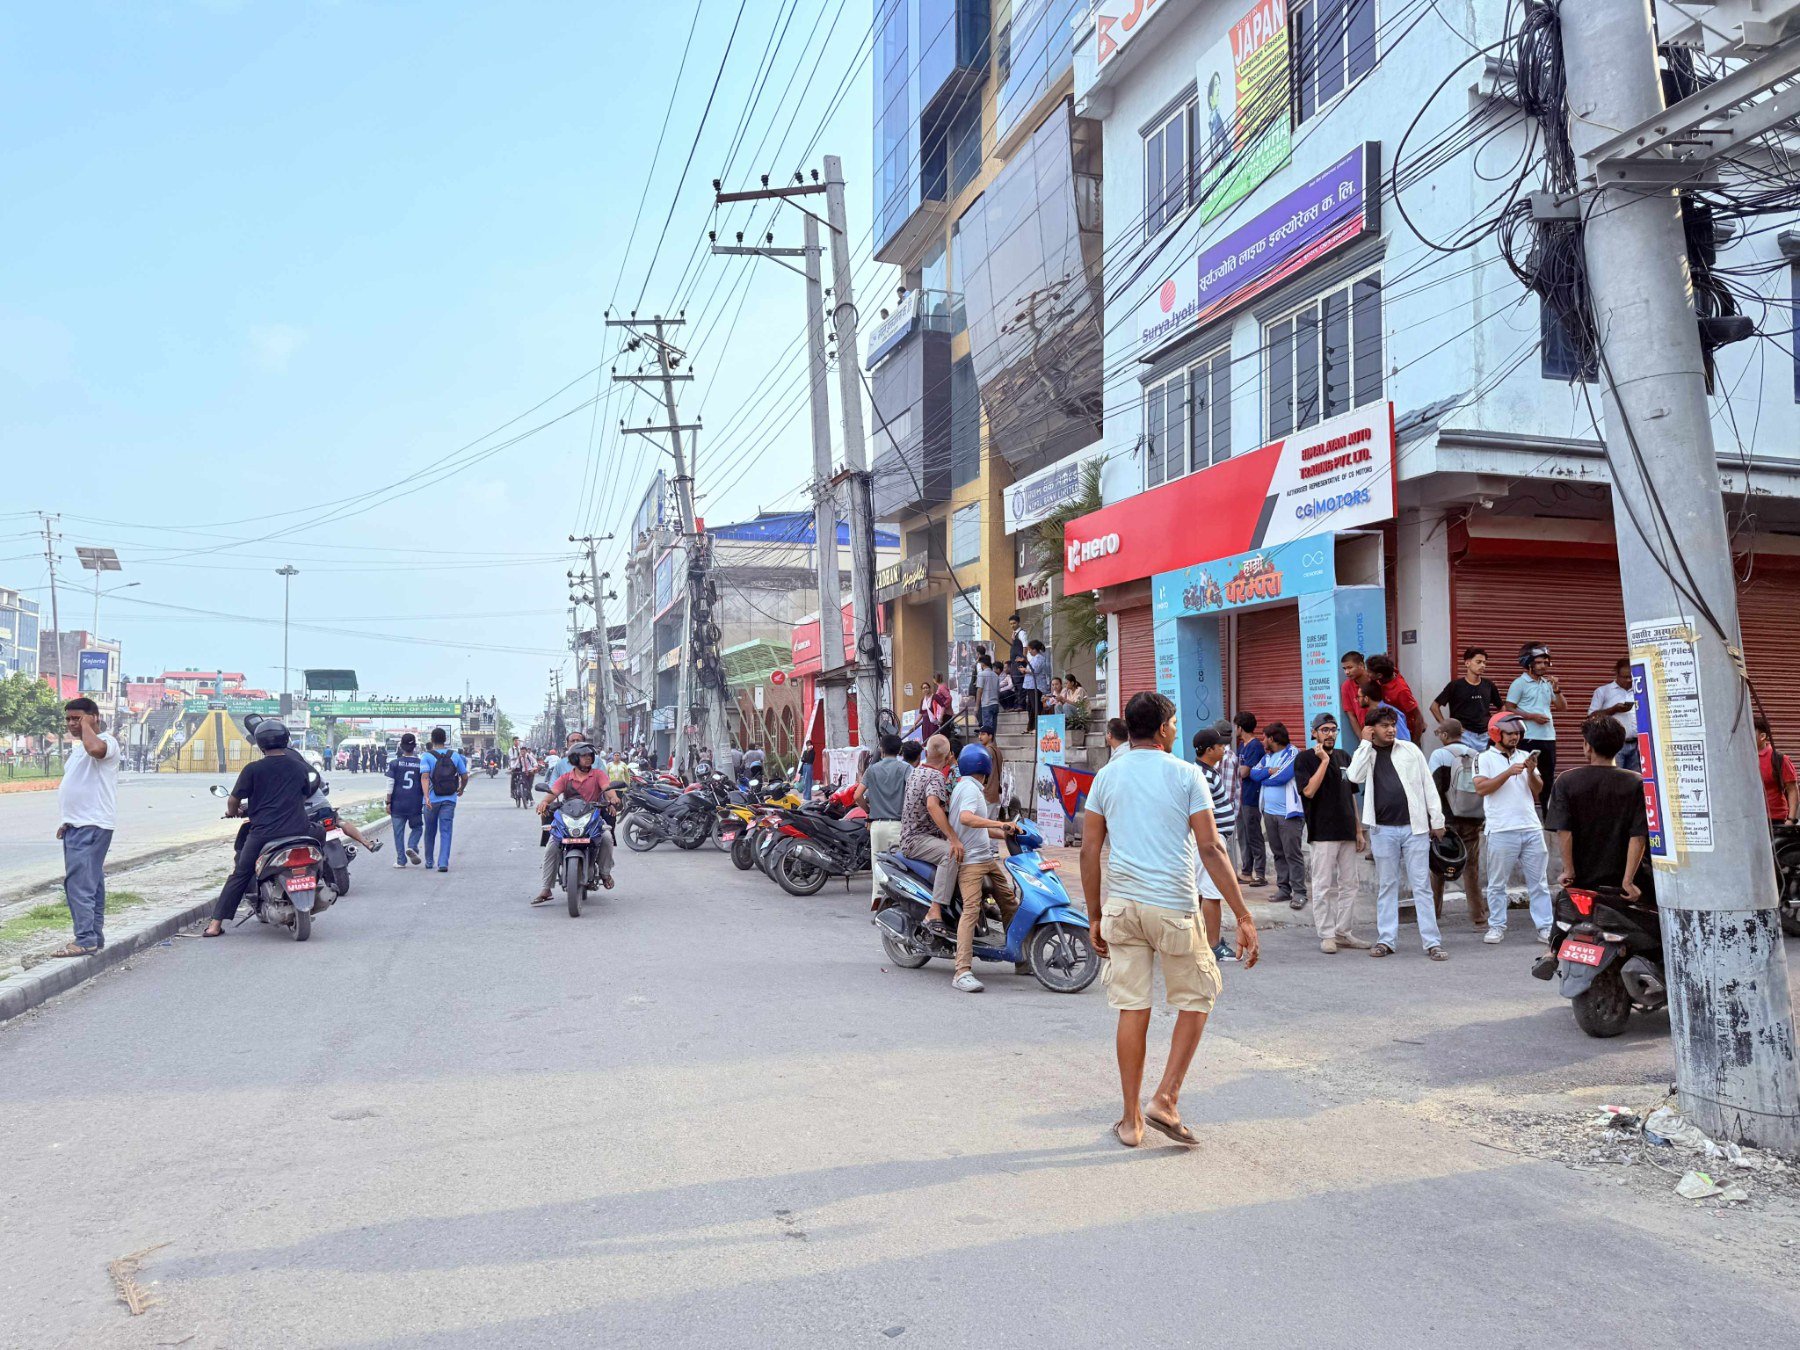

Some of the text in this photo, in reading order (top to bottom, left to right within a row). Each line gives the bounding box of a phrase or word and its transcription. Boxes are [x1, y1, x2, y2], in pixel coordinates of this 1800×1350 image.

[1234, 0, 1284, 66] JAPAN
[1240, 31, 1284, 73] Language Classes
[1247, 49, 1285, 85] Documentation
[1199, 254, 1237, 292] सूर्यज्योति
[1238, 236, 1267, 266] लाइफ
[1268, 203, 1319, 248] इन्स्योरेन्स
[1338, 180, 1356, 202] लि.
[1301, 428, 1371, 461] HIMALAYAN AUTO
[1299, 460, 1334, 480] TRADING
[1353, 448, 1372, 463] LTD.
[1309, 475, 1340, 490] REPRESENTATIVE
[1348, 471, 1355, 479] CG
[1355, 465, 1373, 477] MOTORS
[402, 770, 415, 789] 5
